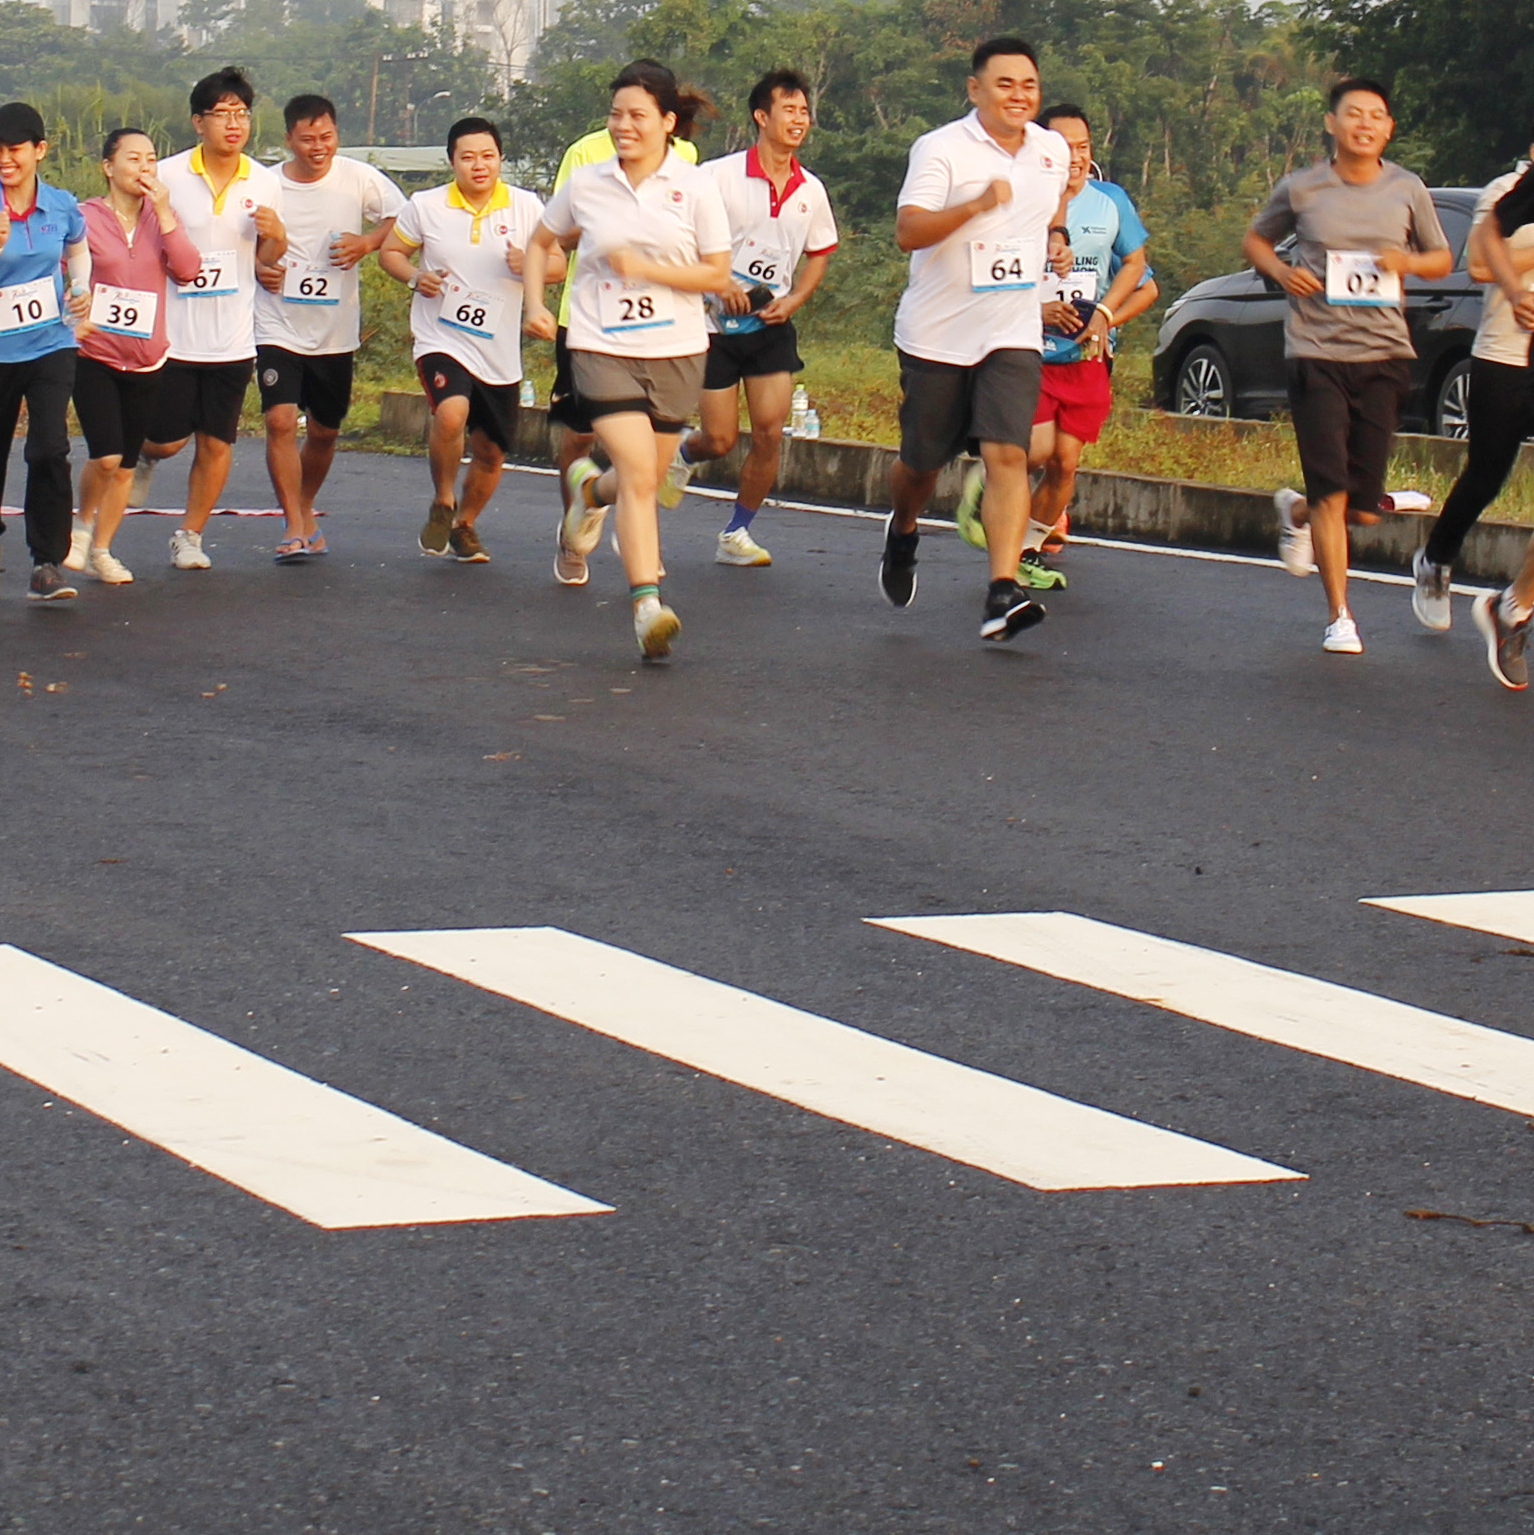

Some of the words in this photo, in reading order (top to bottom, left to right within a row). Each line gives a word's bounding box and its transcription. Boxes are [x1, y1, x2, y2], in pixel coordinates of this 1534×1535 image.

[193, 268, 222, 288] 67
[748, 260, 777, 280] 66
[991, 258, 1023, 281] 64
[299, 277, 328, 296] 62
[1347, 272, 1381, 296] 02
[12, 299, 43, 323] 10
[107, 304, 138, 326] 39
[456, 304, 487, 327] 68
[619, 296, 655, 321] 28
